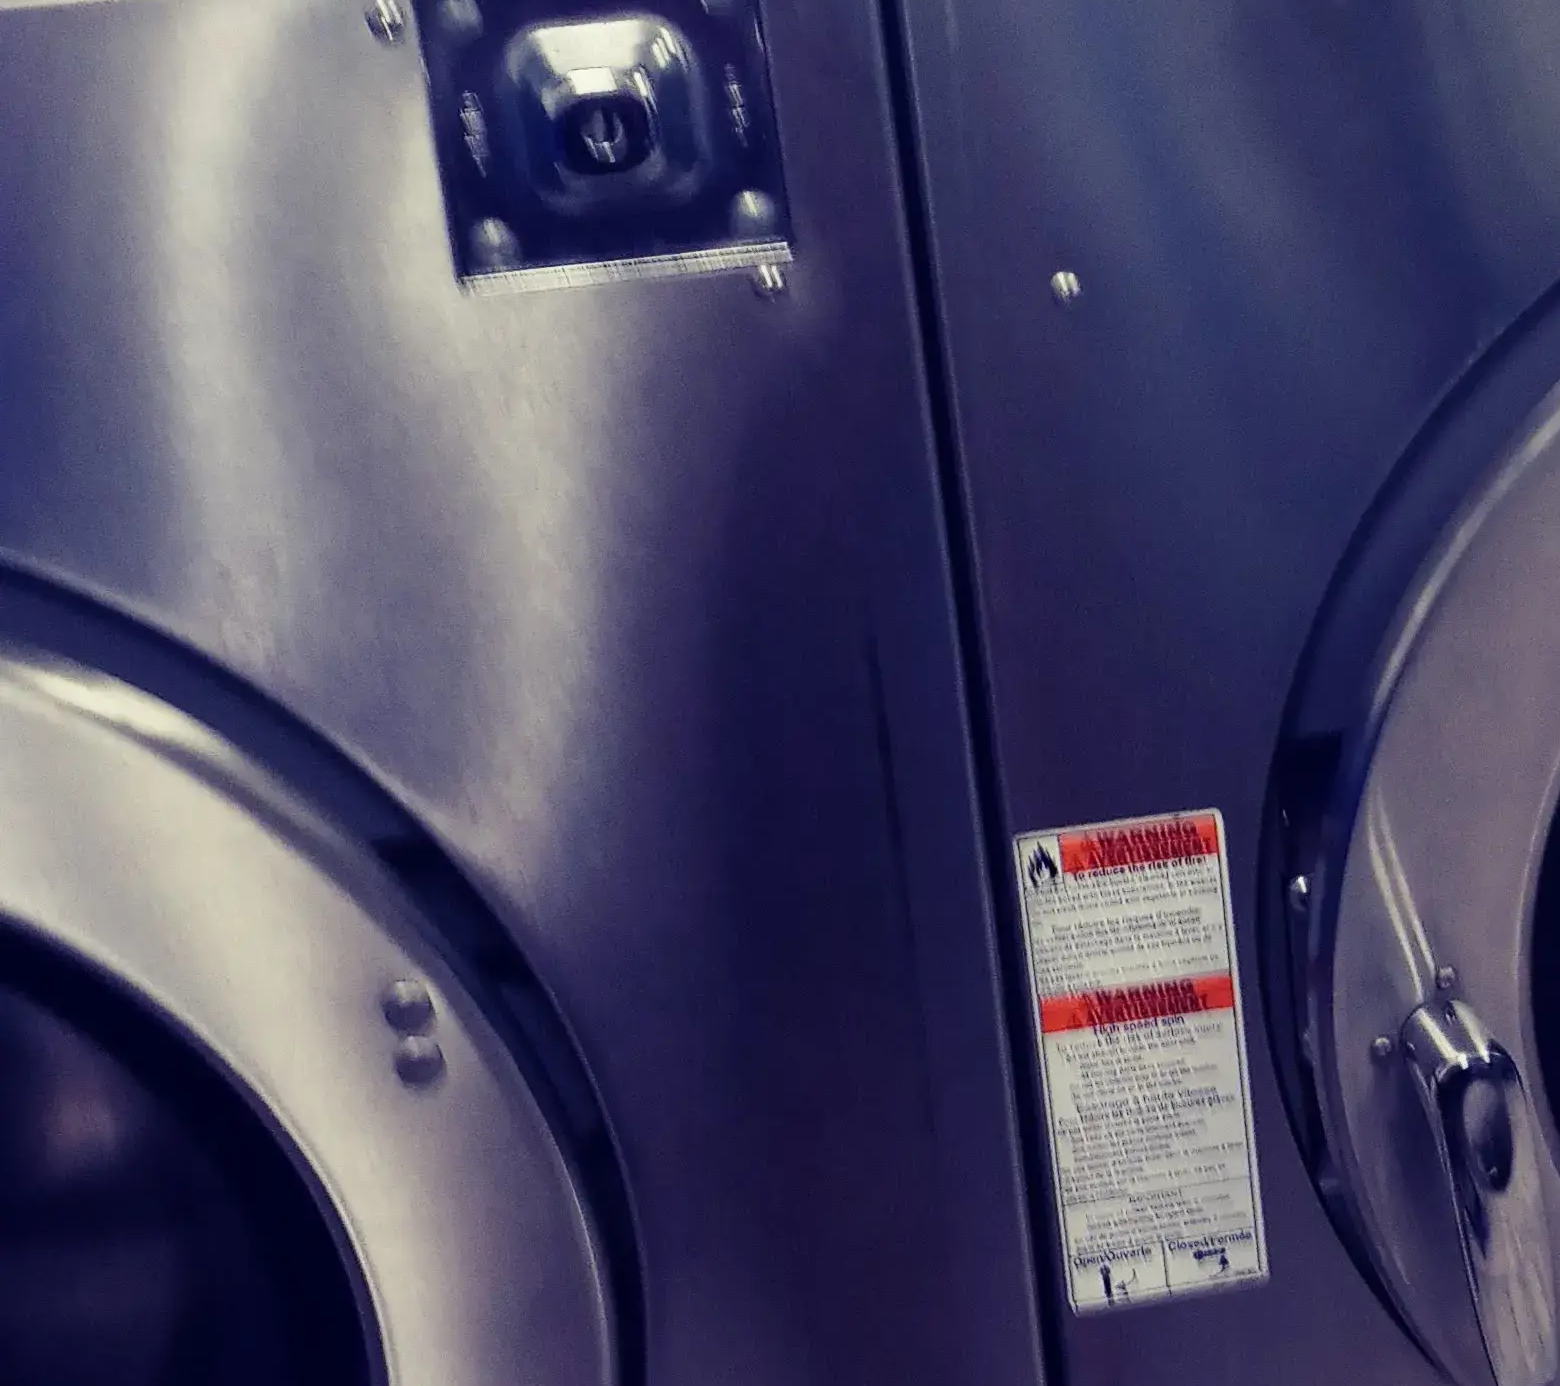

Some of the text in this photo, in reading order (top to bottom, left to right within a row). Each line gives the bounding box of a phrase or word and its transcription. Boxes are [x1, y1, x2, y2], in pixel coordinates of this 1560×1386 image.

[1088, 866, 1125, 879] reduce
[1128, 863, 1145, 873] the
[1148, 860, 1168, 870] risk
